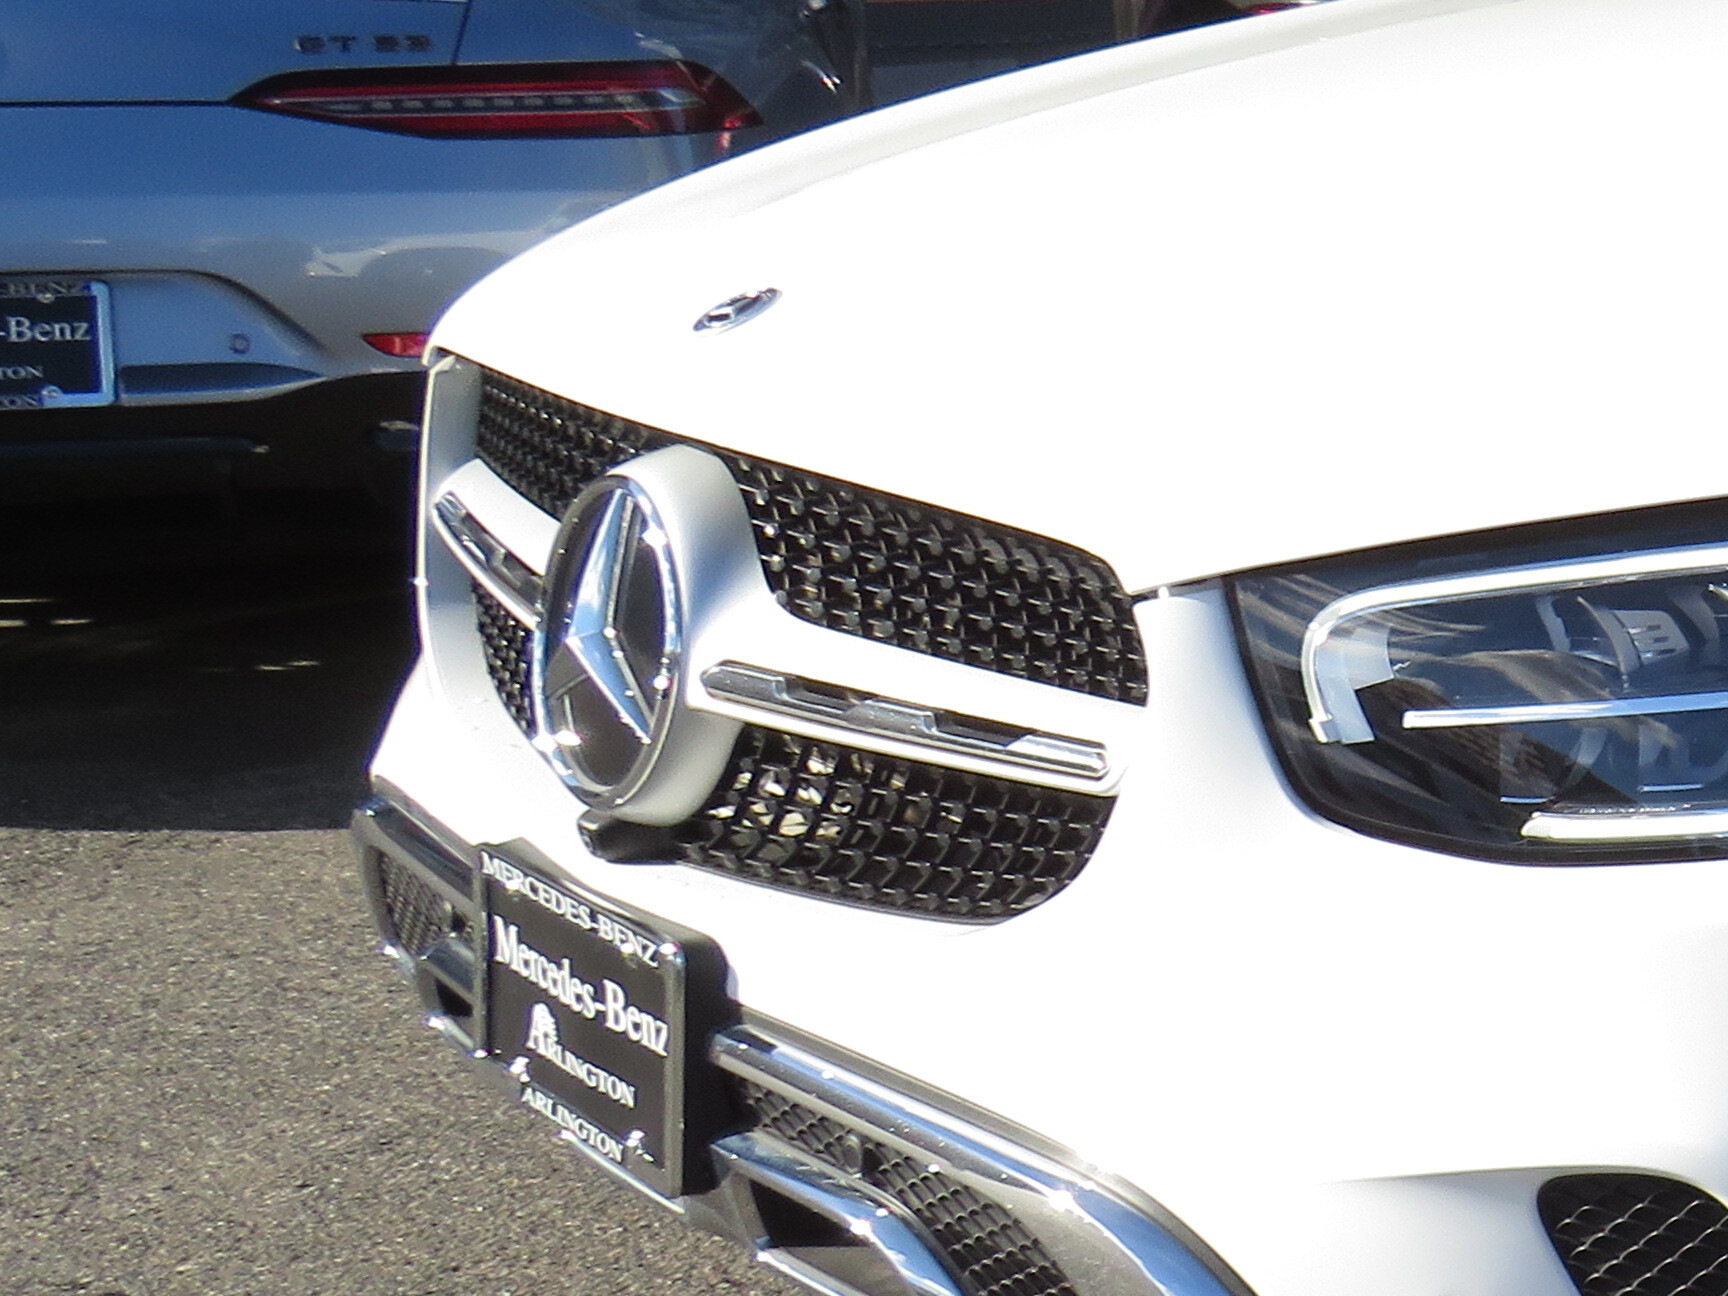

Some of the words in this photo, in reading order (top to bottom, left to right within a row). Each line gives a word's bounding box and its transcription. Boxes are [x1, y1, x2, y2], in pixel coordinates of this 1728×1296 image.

[482, 851, 660, 968] MERCEDES-BENZ
[492, 915, 669, 1057] Mercedes-Benz
[526, 1007, 636, 1108] ARLINGTON
[520, 1085, 624, 1164] ARLINGTON
